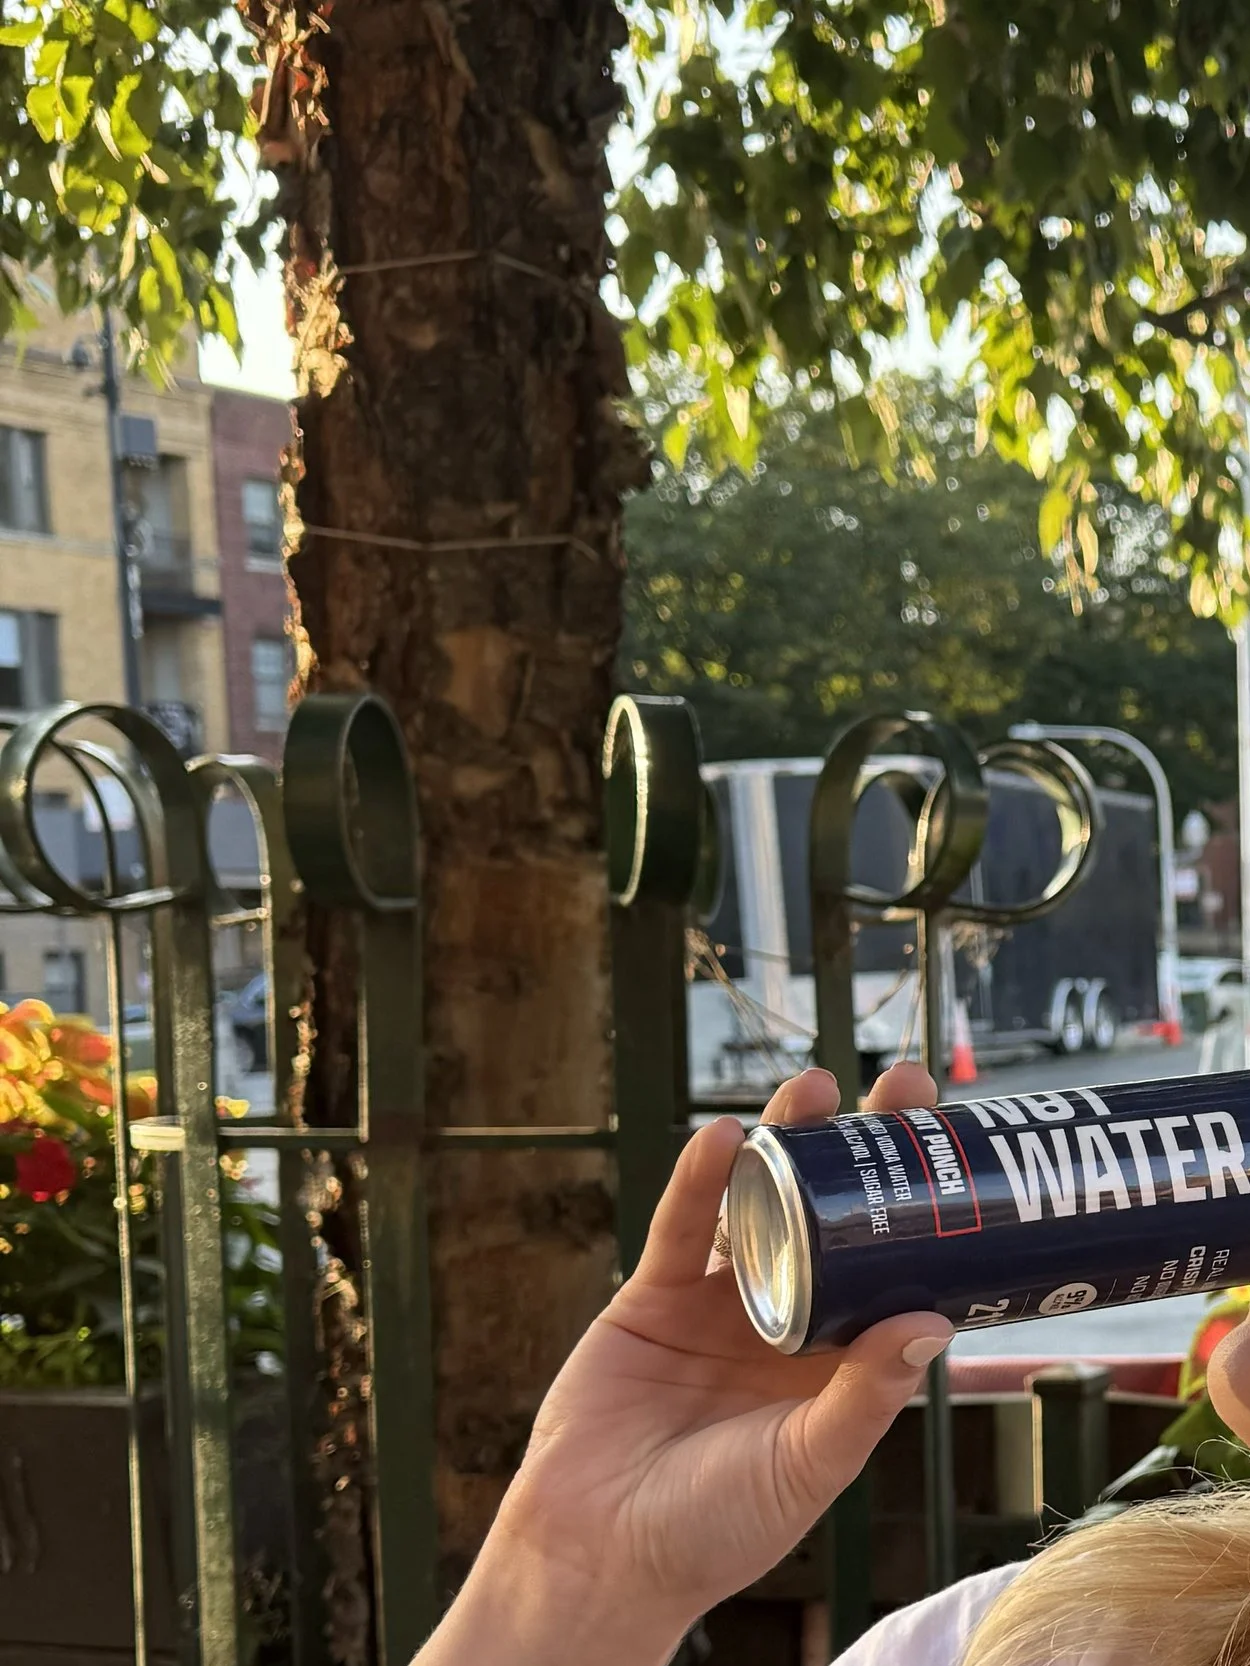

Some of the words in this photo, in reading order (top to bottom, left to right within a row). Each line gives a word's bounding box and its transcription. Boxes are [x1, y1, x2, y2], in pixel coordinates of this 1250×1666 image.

[840, 1129, 872, 1162] ALC/VOL
[874, 1135, 901, 1164] VODKA
[922, 1133, 966, 1195] PUNCH
[860, 1168, 885, 1205] SUGAR
[887, 1164, 913, 1201] WATER
[869, 1206, 890, 1235] FREE
[1160, 1259, 1179, 1281] NO
[1181, 1245, 1206, 1288] CRISP
[1205, 1248, 1230, 1281] REAL
[1130, 1274, 1151, 1294] NO
